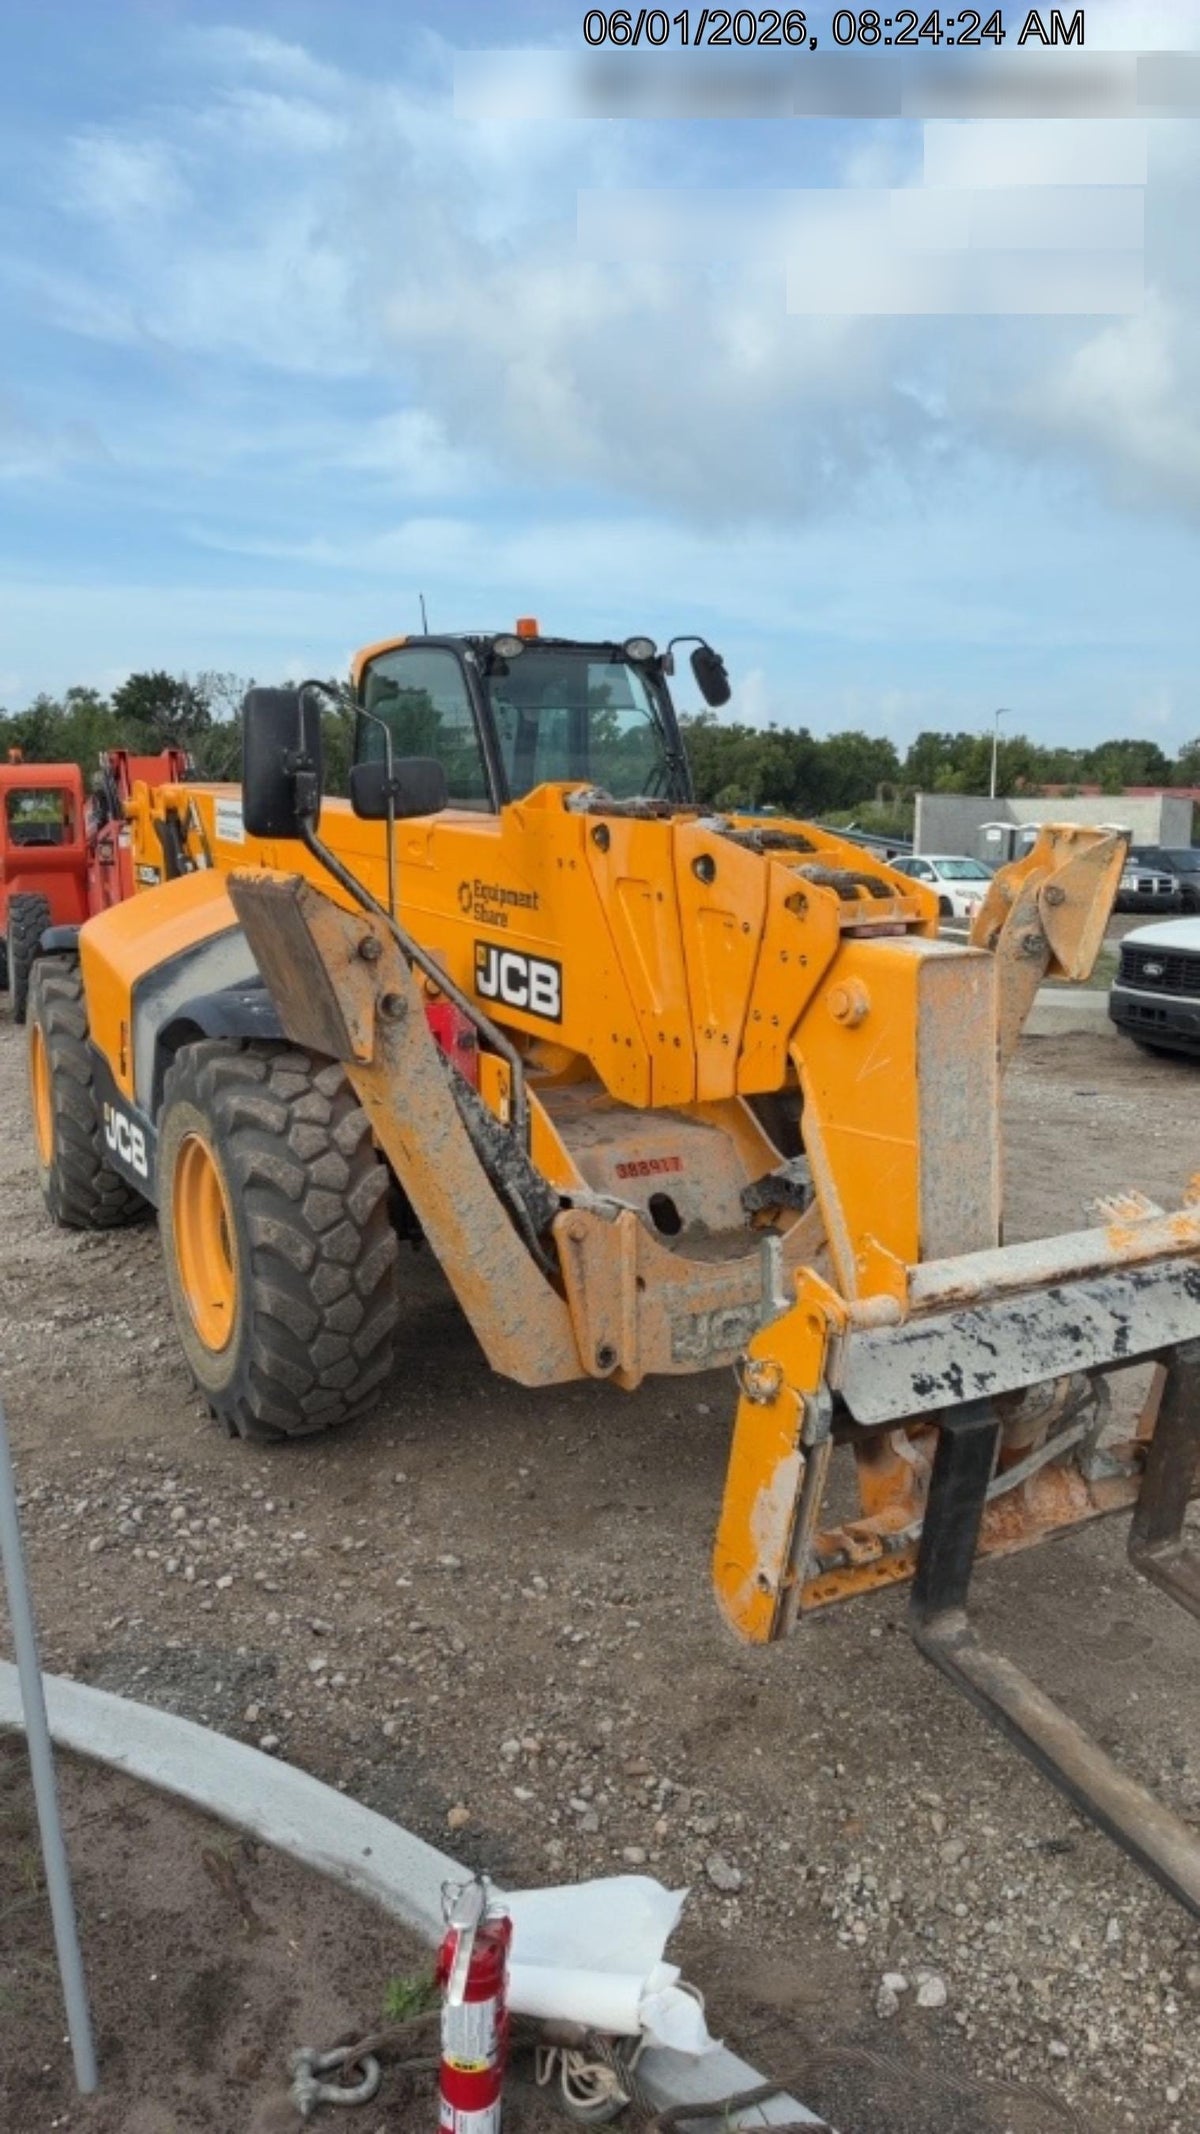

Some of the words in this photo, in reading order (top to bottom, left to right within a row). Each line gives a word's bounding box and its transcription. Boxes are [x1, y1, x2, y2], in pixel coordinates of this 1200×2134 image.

[474, 879, 539, 911] Equipment
[474, 903, 508, 928] Share
[476, 946, 561, 1018] JCB
[104, 1102, 148, 1178] JCB
